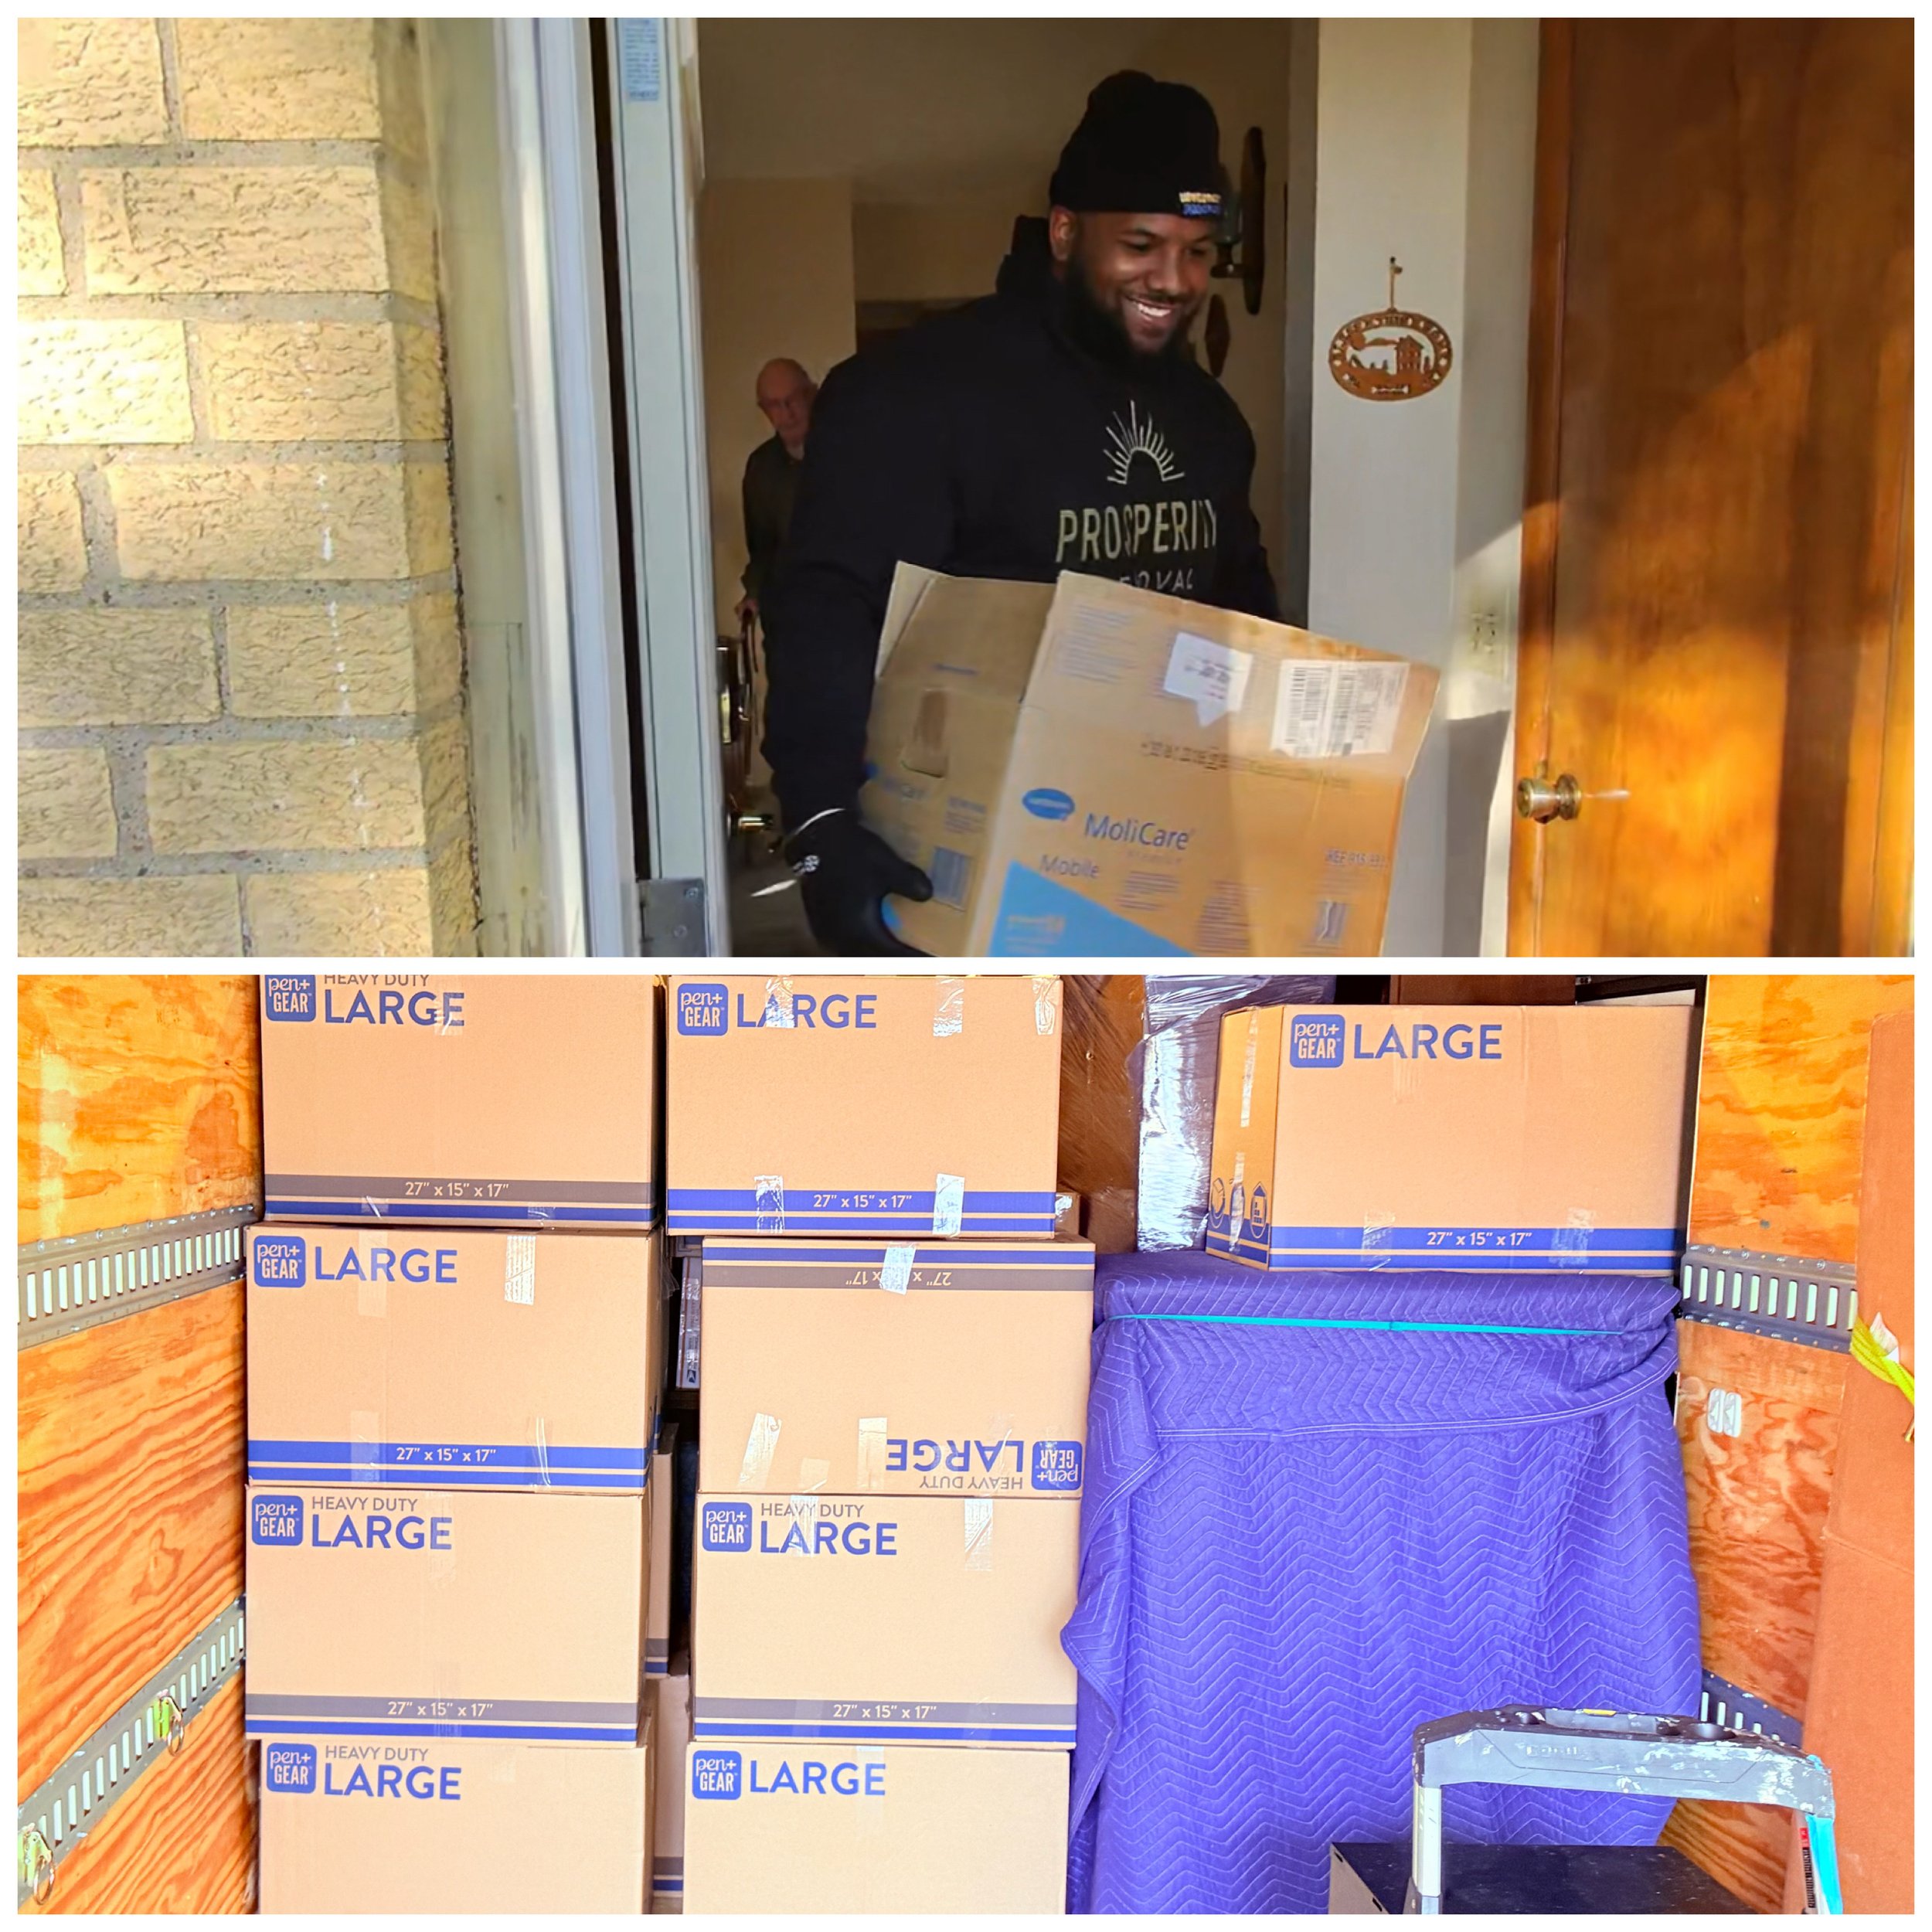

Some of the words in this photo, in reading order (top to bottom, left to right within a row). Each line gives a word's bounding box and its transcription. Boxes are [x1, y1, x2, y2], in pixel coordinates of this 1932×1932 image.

[1084, 813, 1189, 850] MoliCare
[1040, 855, 1100, 879] Mobile
[267, 977, 310, 998] pen+
[273, 994, 308, 1013] GEAR
[325, 990, 464, 1026] LARGE
[680, 992, 723, 1012] pen+
[685, 1008, 720, 1027] GEAR
[1295, 1023, 1339, 1043] pen+
[1353, 1023, 1502, 1060] LARGE
[1298, 1040, 1336, 1060] GEAR
[405, 1182, 430, 1196] 27"
[434, 1185, 443, 1196] x
[447, 1182, 470, 1196] 15"
[474, 1186, 483, 1197] x
[487, 1183, 509, 1197] 17"
[813, 1194, 837, 1208] 27"
[841, 1198, 849, 1208] x
[854, 1195, 875, 1208] 15"
[879, 1198, 887, 1208] x
[891, 1195, 912, 1208] 17"
[1427, 1232, 1453, 1246] 27"
[1456, 1235, 1465, 1246] x
[1470, 1232, 1493, 1246] 15"
[1496, 1235, 1505, 1246] x
[1509, 1232, 1532, 1246] 17"
[257, 1243, 300, 1264] pen+
[261, 1259, 299, 1279] GEAR
[315, 1247, 457, 1284] LARGE
[396, 1447, 420, 1461] 27"
[424, 1451, 433, 1461] x
[437, 1447, 459, 1461] 15"
[463, 1451, 471, 1462] x
[475, 1448, 496, 1462] 17"
[886, 1440, 1023, 1472] LARGE
[1040, 1449, 1075, 1468] GEAR
[920, 1475, 964, 1488] DUTY
[968, 1476, 1023, 1490] HEAVY
[1036, 1464, 1078, 1483] pen+
[255, 1502, 298, 1522] pen+
[311, 1495, 369, 1511] HEAVY
[373, 1498, 417, 1512] DUTY
[761, 1503, 815, 1517] HEAVY
[820, 1505, 864, 1518] DUTY
[260, 1519, 295, 1537] GEAR
[705, 1509, 747, 1530] pen+
[311, 1514, 452, 1549] LARGE
[710, 1525, 744, 1543] GEAR
[760, 1521, 897, 1556] LARGE
[387, 1702, 413, 1716] 27"
[417, 1706, 426, 1716] x
[430, 1702, 453, 1716] 15"
[457, 1706, 467, 1716] x
[471, 1703, 493, 1717] 17"
[833, 1705, 858, 1718] 27"
[862, 1708, 870, 1718] x
[875, 1705, 897, 1718] 15"
[901, 1708, 910, 1719] x
[915, 1706, 937, 1719] 17"
[270, 1750, 311, 1770] pen+
[325, 1746, 381, 1760] HEAVY
[385, 1747, 429, 1762] DUTY
[274, 1764, 308, 1785] GEAR
[696, 1757, 736, 1777] pen+
[325, 1763, 461, 1801] LARGE
[699, 1774, 733, 1792] GEAR
[750, 1760, 886, 1796] LARGE
